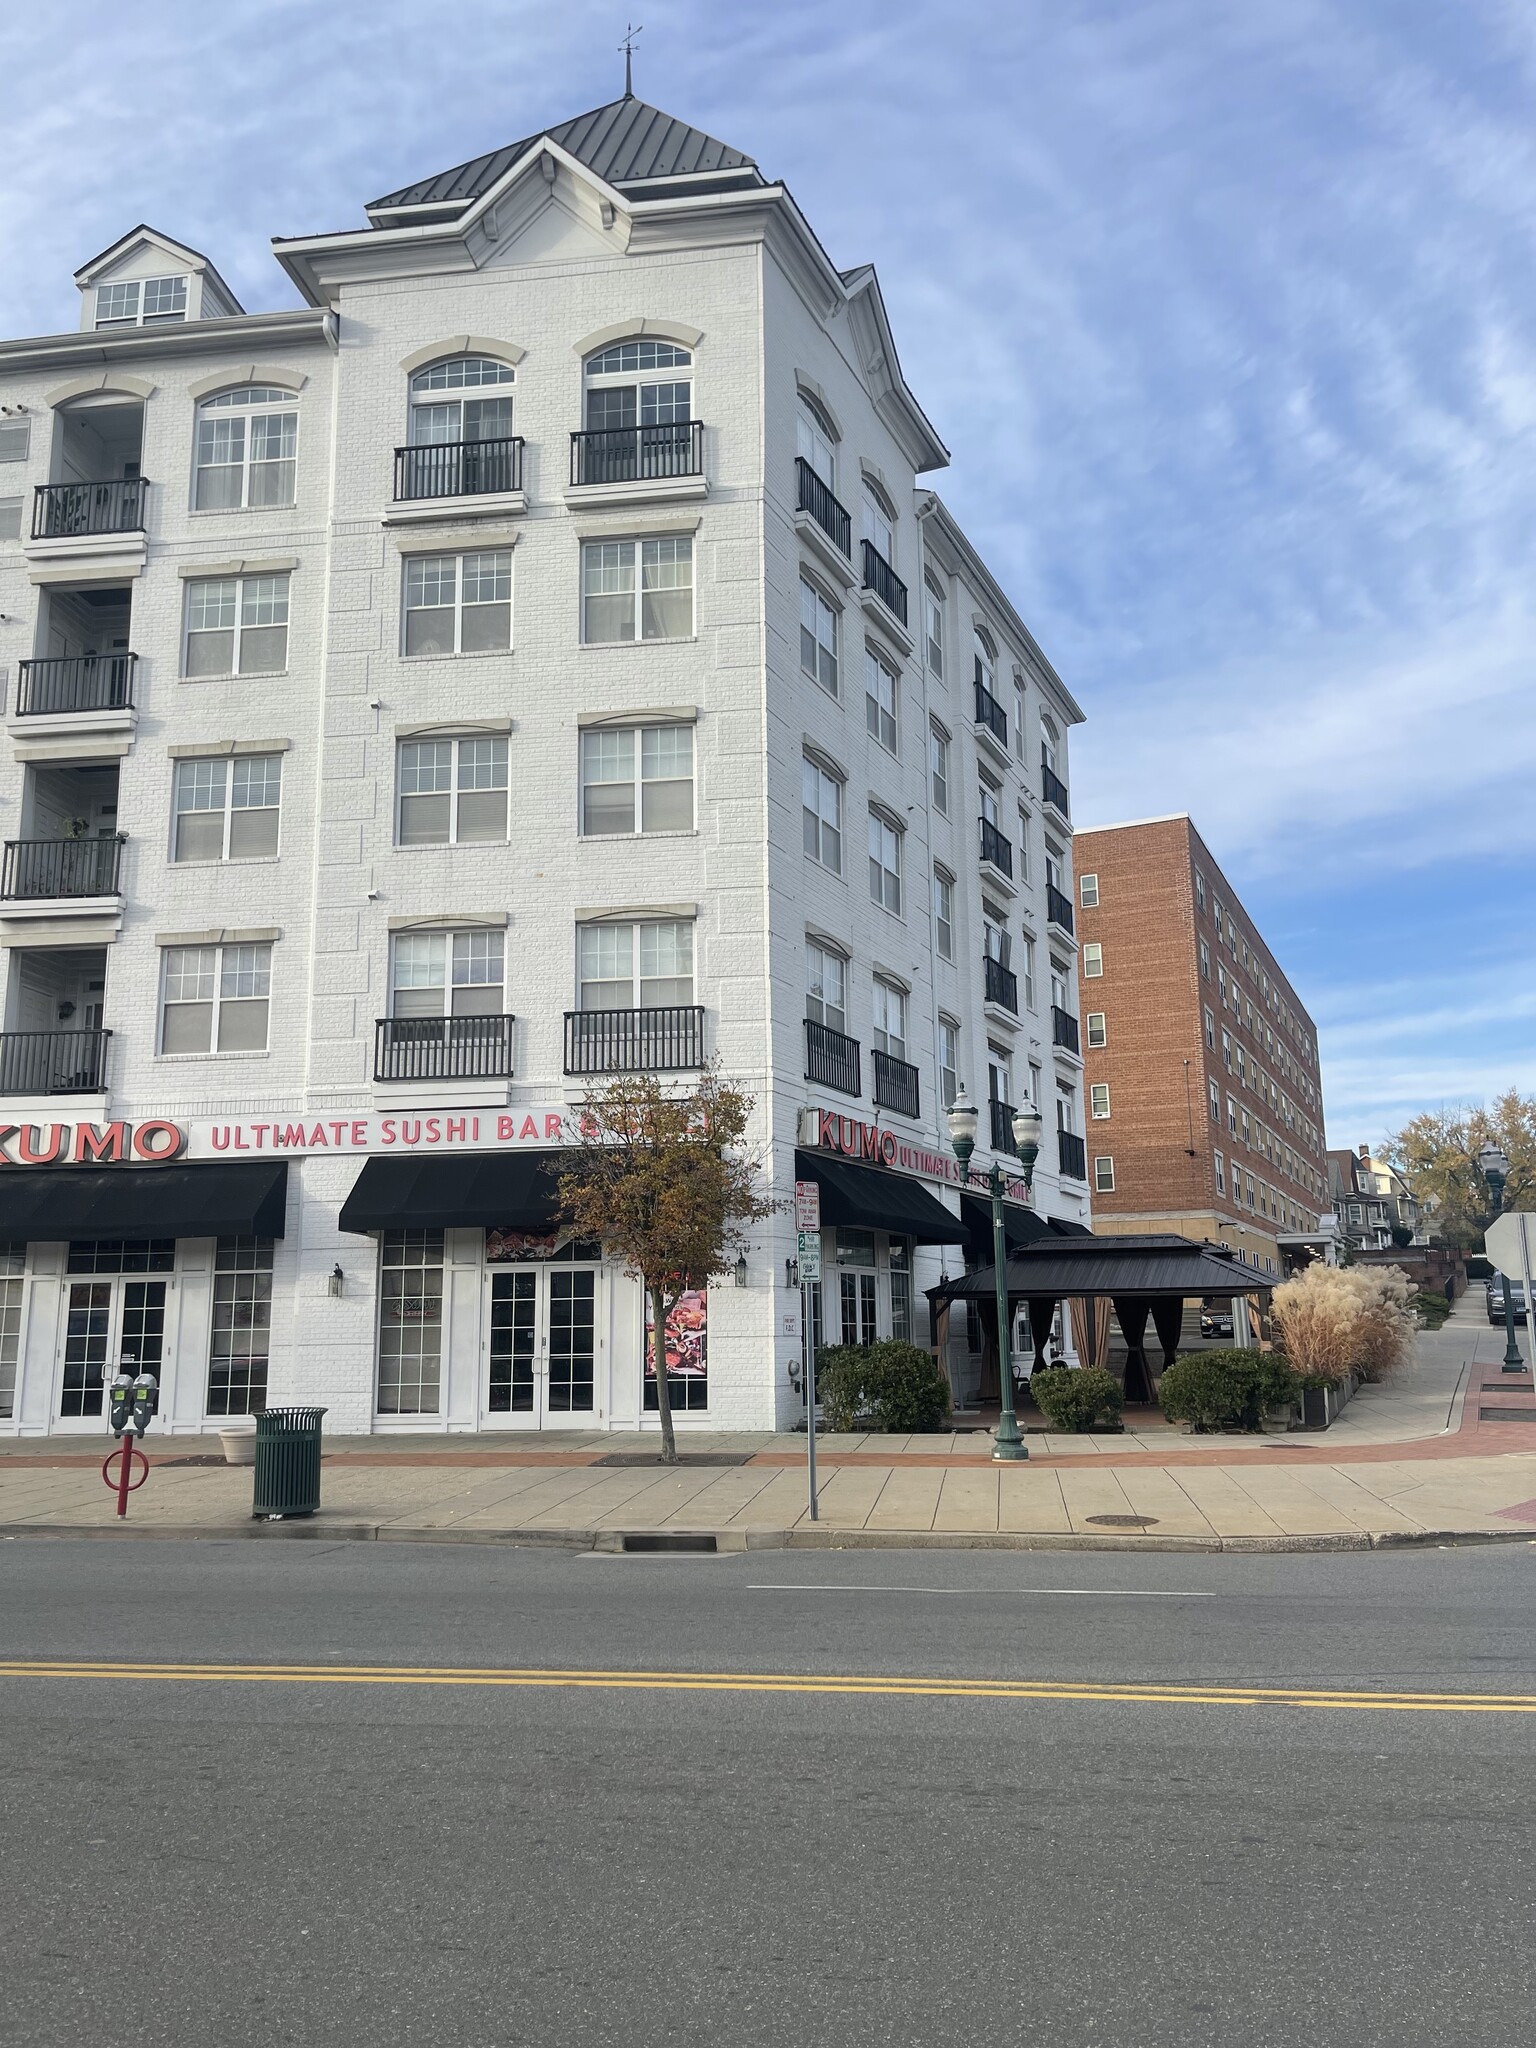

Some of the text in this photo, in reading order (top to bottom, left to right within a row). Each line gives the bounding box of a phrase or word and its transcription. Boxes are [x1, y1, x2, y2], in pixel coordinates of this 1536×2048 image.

[211, 1121, 368, 1150] ULTIMATE
[381, 1117, 479, 1145] SUSHI
[497, 1113, 563, 1140] BAR
[818, 1108, 898, 1166] KUMO
[900, 1146, 951, 1179] ULTIMATE
[799, 1237, 805, 1248] 2
